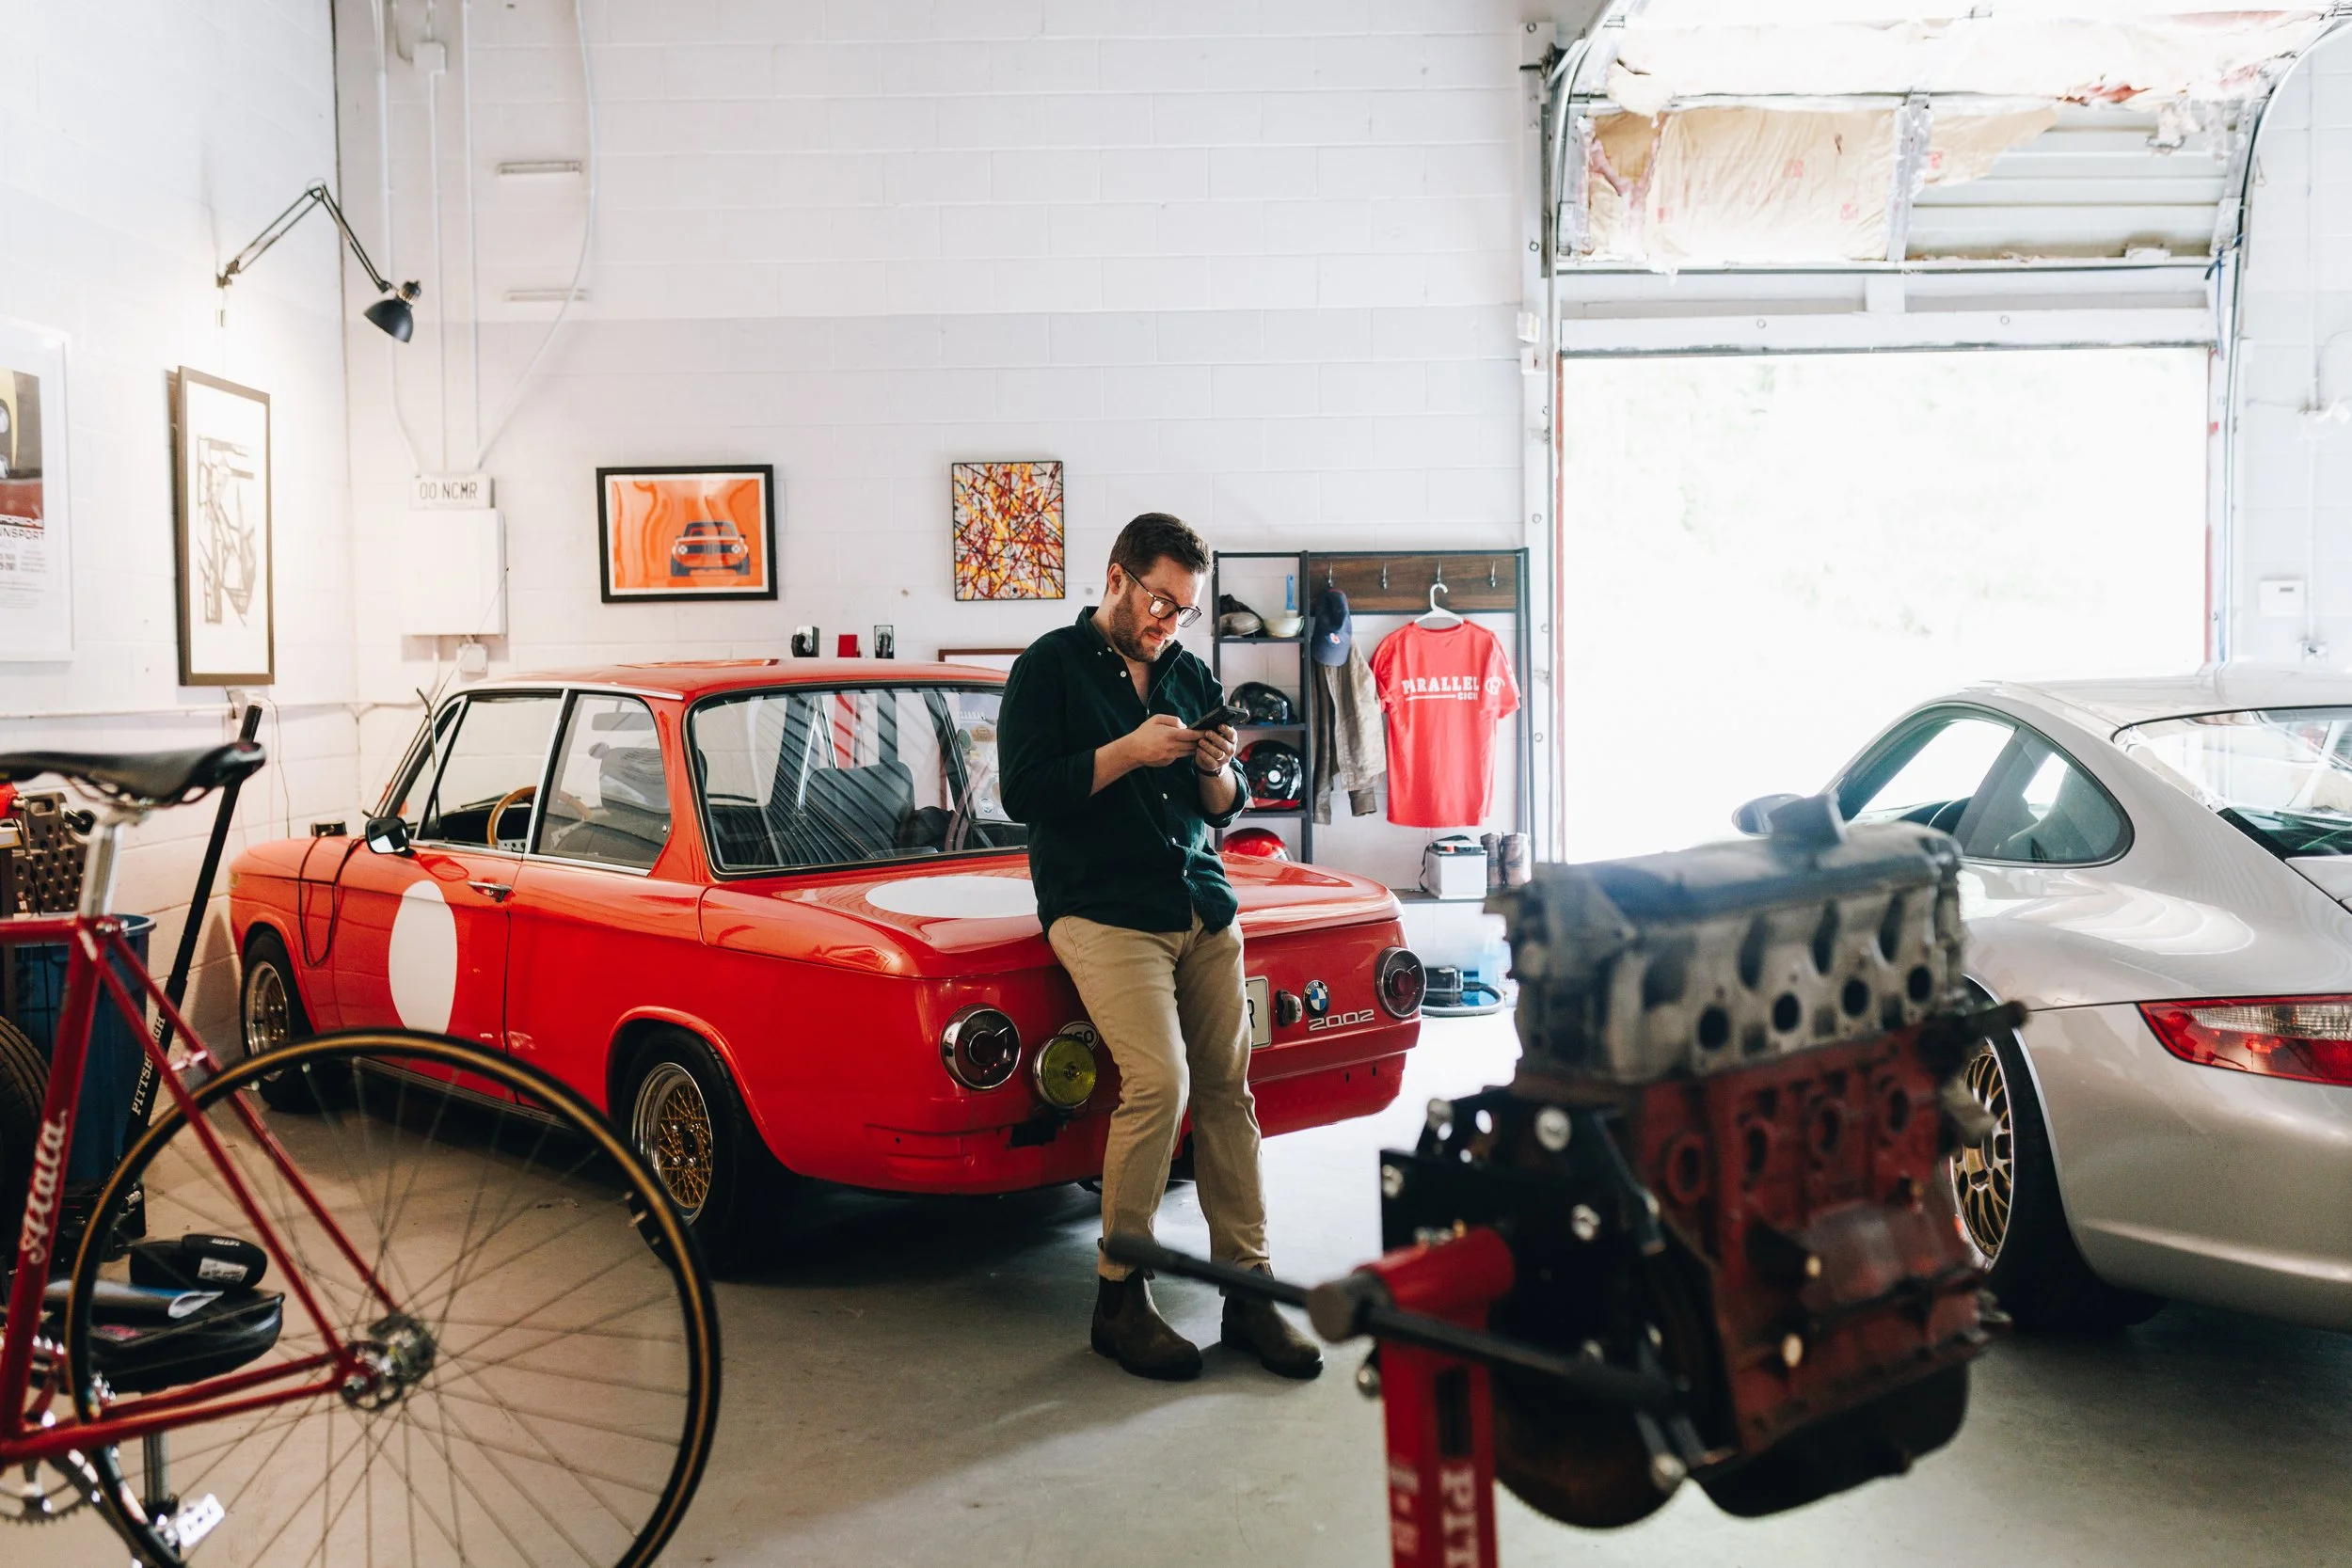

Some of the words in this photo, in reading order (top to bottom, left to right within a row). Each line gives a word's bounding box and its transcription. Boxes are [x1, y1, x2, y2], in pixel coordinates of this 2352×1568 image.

[442, 482, 478, 499] NCMR
[1402, 675, 1480, 695] PARALLEL
[1308, 1008, 1375, 1032] 2002
[132, 1015, 167, 1117] PITTSBGH
